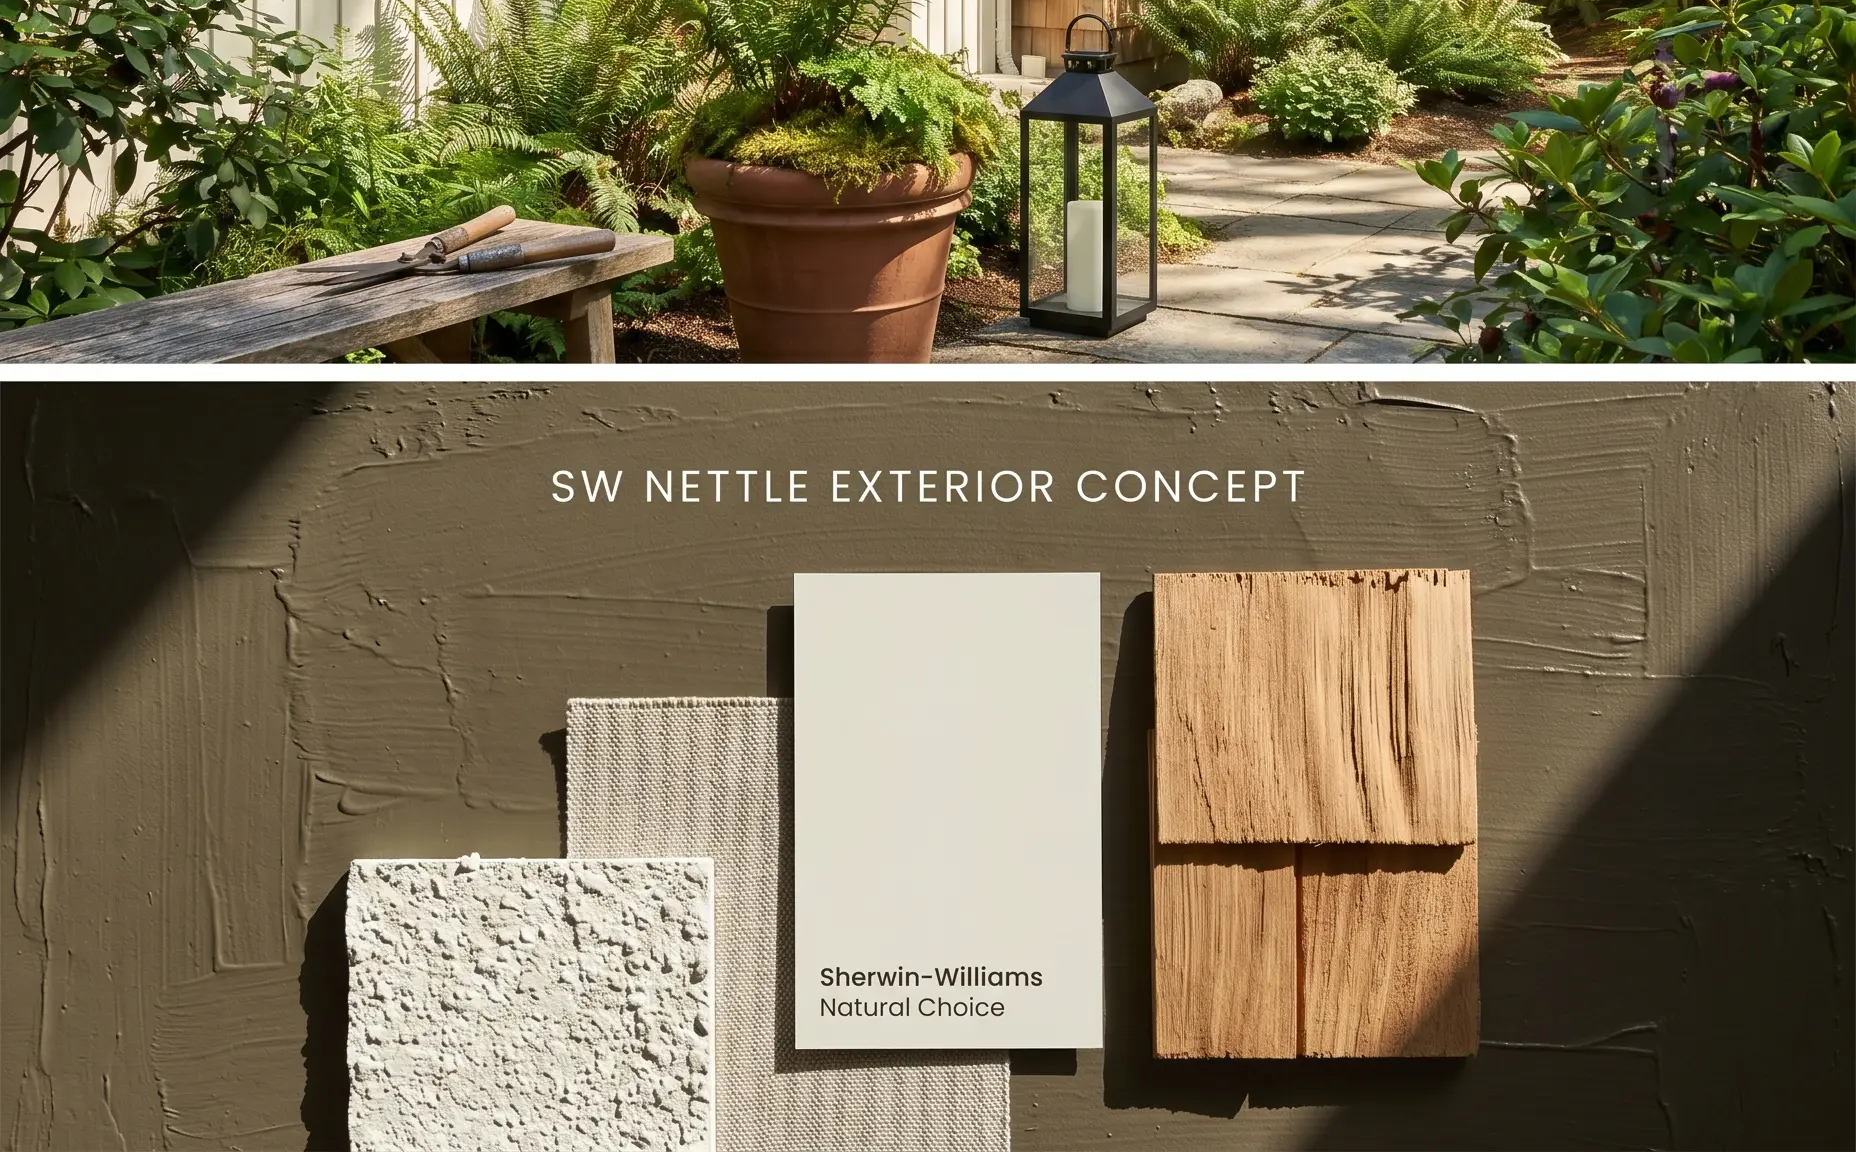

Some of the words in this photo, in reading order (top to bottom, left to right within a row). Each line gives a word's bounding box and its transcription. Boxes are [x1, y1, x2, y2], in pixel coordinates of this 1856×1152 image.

[820, 966, 1043, 987] Sherwin-Williams
[820, 997, 910, 1017] Natural
[918, 997, 1005, 1017] Choice
